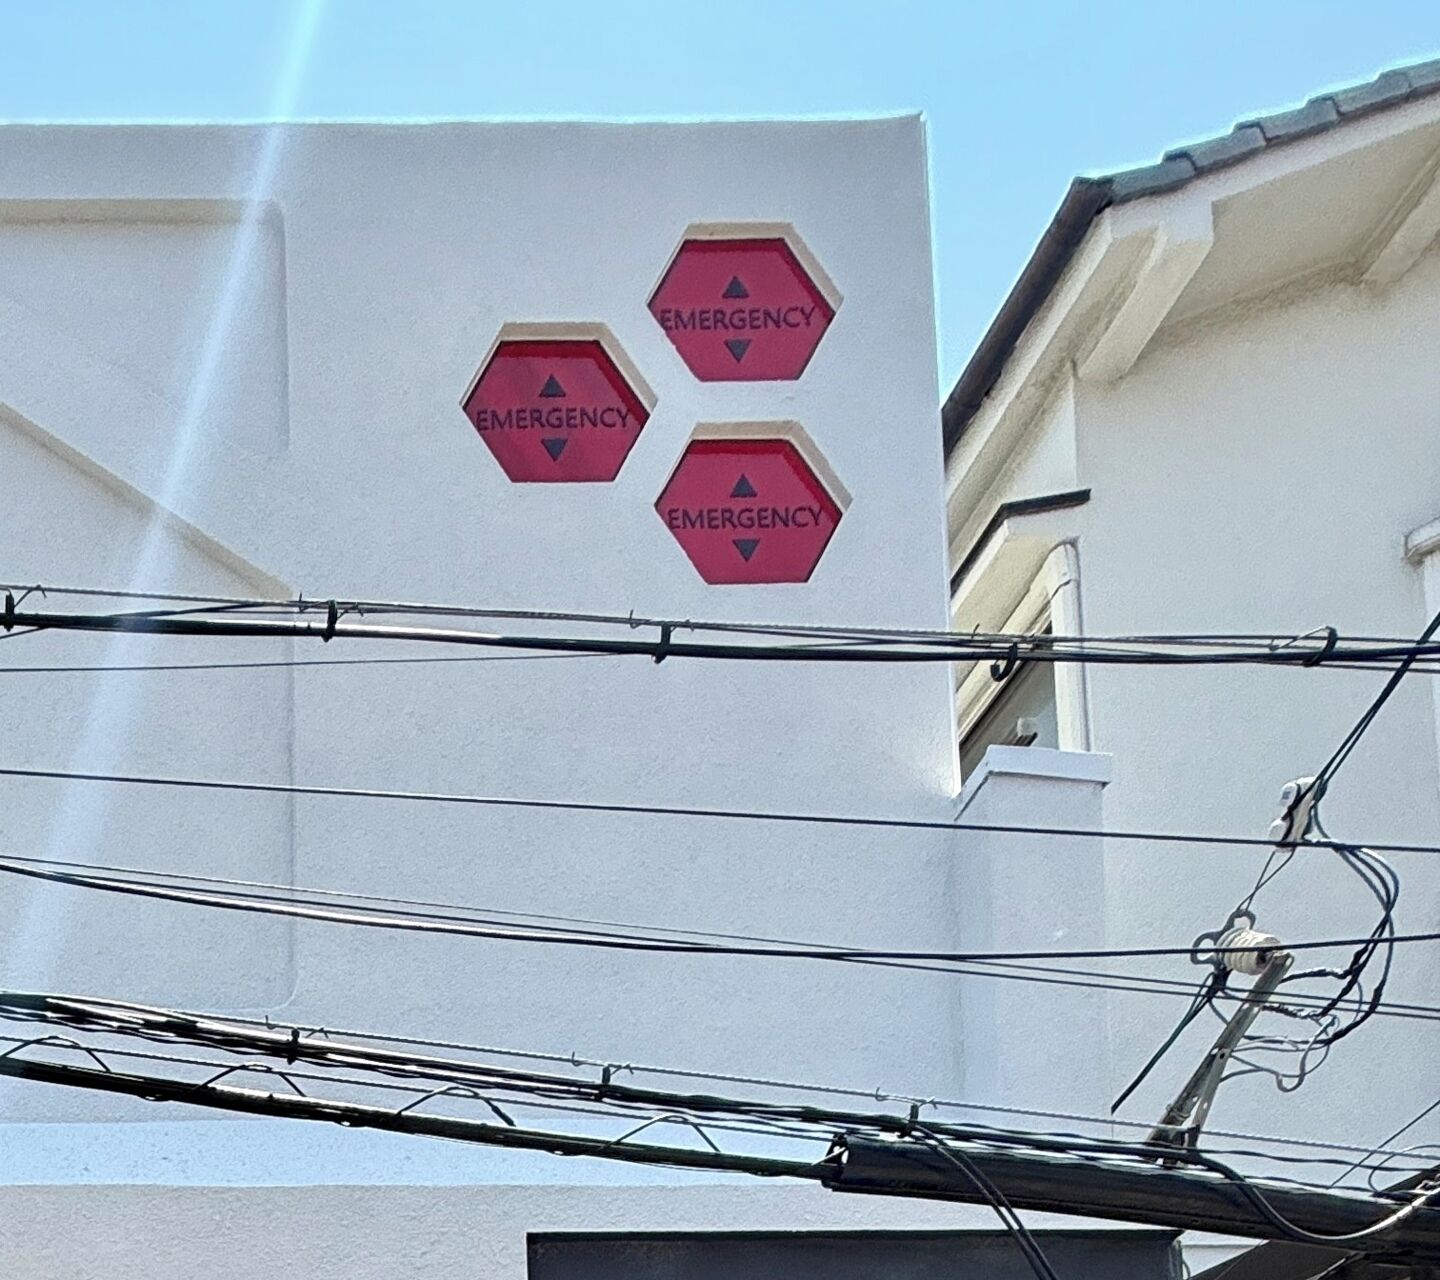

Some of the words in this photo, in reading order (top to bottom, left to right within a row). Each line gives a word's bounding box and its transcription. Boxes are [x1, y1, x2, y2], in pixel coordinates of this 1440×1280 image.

[660, 304, 817, 332] EMERGENCY
[475, 406, 631, 432] EMERGENCY
[667, 505, 824, 531] EMERGENCY
